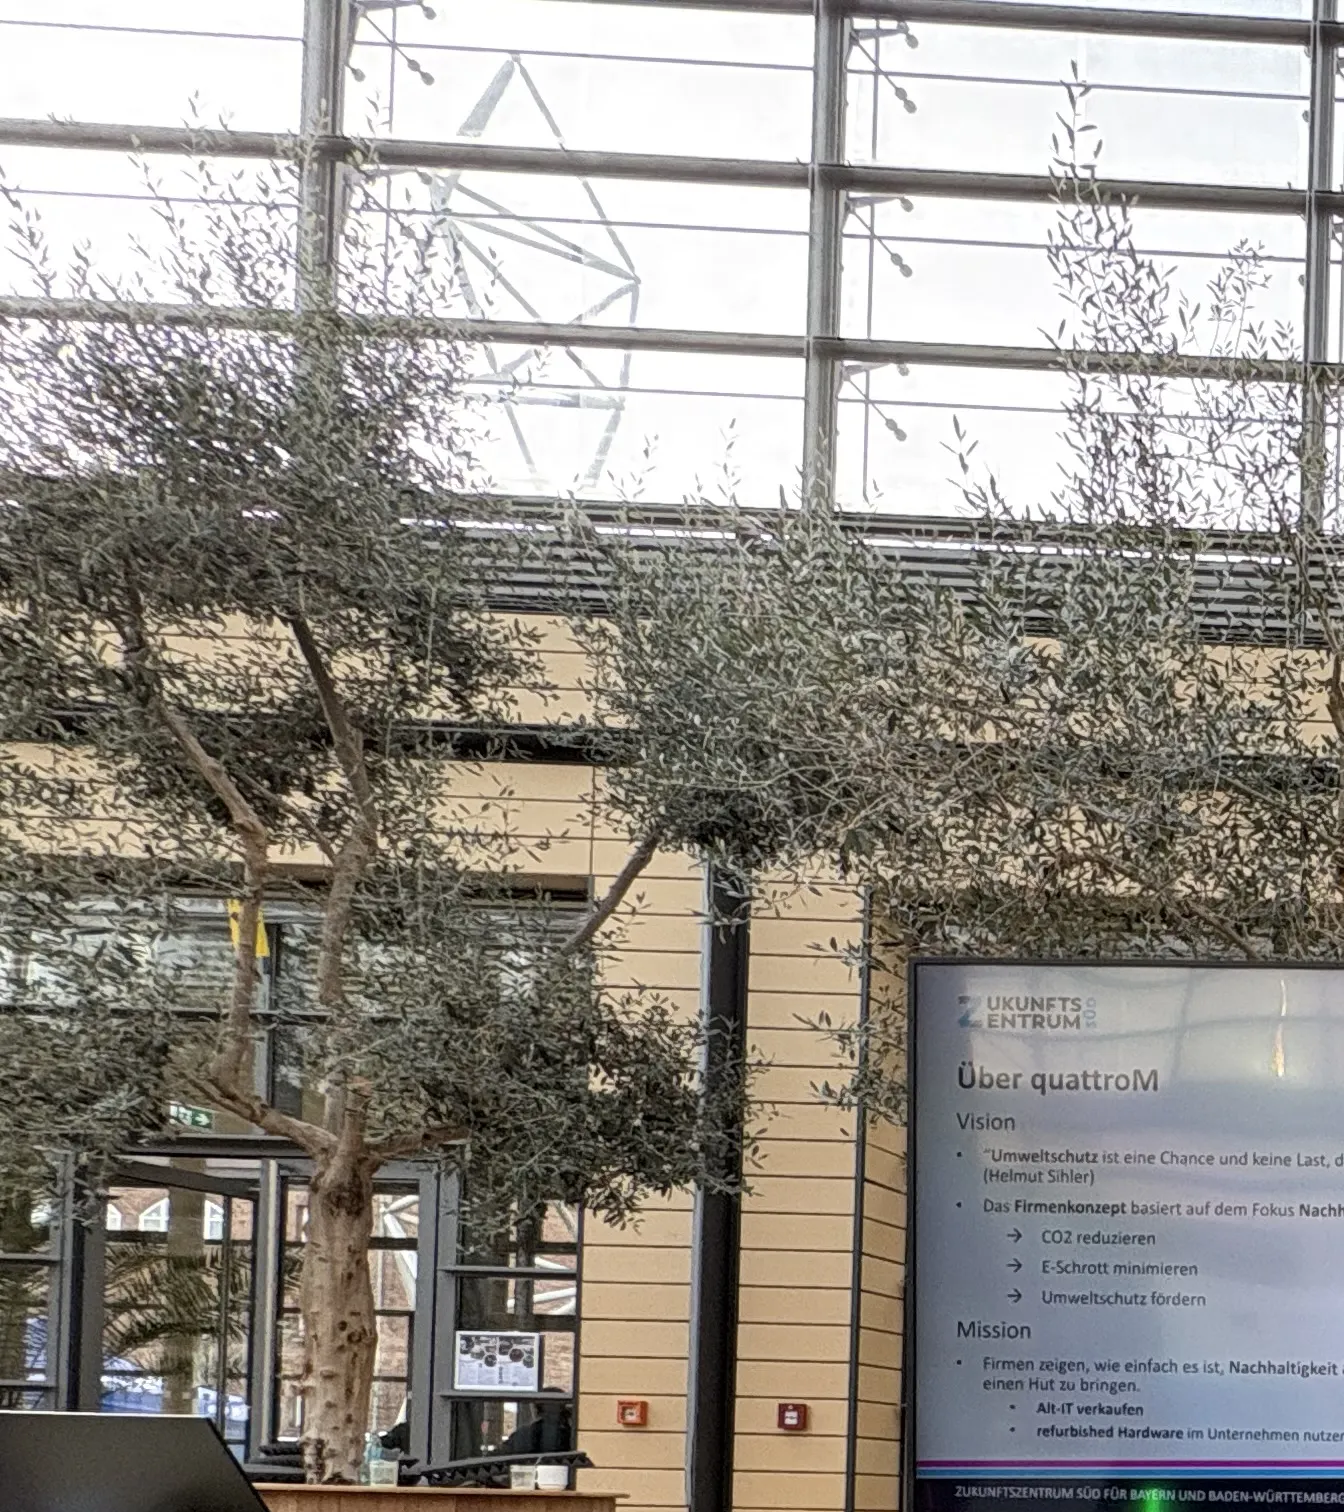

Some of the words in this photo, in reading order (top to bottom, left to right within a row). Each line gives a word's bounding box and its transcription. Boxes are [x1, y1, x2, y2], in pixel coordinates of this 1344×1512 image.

[957, 1060, 1024, 1090] Über
[1030, 1068, 1160, 1096] quattroM
[956, 1112, 1016, 1131] Vision
[1102, 1150, 1120, 1164] ist
[1124, 1150, 1156, 1165] eine
[1160, 1151, 1215, 1166] Chance
[1219, 1151, 1249, 1167] und
[1252, 1152, 1292, 1168] keine
[1296, 1153, 1331, 1169] Last,
[983, 1168, 1045, 1184] (Helmut
[983, 1198, 1010, 1213] Das
[1014, 1199, 1127, 1217] Firmenkonzept
[1131, 1201, 1183, 1216] basiert
[1186, 1201, 1211, 1216] auf
[1214, 1202, 1248, 1216] dem
[1252, 1202, 1295, 1217] Fokus
[1041, 1229, 1073, 1245] CO2
[1076, 1230, 1157, 1246] reduzieren
[1041, 1260, 1110, 1275] E-Schrott
[1113, 1262, 1198, 1276] minimieren
[1041, 1289, 1147, 1306] Umweltschutz
[1150, 1290, 1207, 1306] fördern
[956, 1320, 1032, 1339] Mission
[982, 1356, 1035, 1371] Firmen
[1039, 1358, 1091, 1375] zeigen,
[1094, 1359, 1121, 1373] wie
[1124, 1358, 1178, 1374] einfach
[1182, 1362, 1199, 1374] es
[1229, 1360, 1338, 1378] Nachhaltigkeit
[982, 1376, 1024, 1391] einen
[1028, 1377, 1055, 1392] Hut
[1059, 1380, 1075, 1392] zu
[1080, 1378, 1141, 1395] bringen.
[1036, 1402, 1075, 1415] Alt-IT
[1077, 1402, 1144, 1417] verkaufen
[1036, 1424, 1114, 1439] refurbished
[1118, 1425, 1184, 1440] Hardware
[1187, 1427, 1204, 1440] im
[1207, 1428, 1300, 1441] Unternehmen
[954, 1485, 1074, 1499] ZUKUNFTSZENTRUM
[1130, 1488, 1176, 1500] BAYERN
[1178, 1489, 1206, 1502] UND
